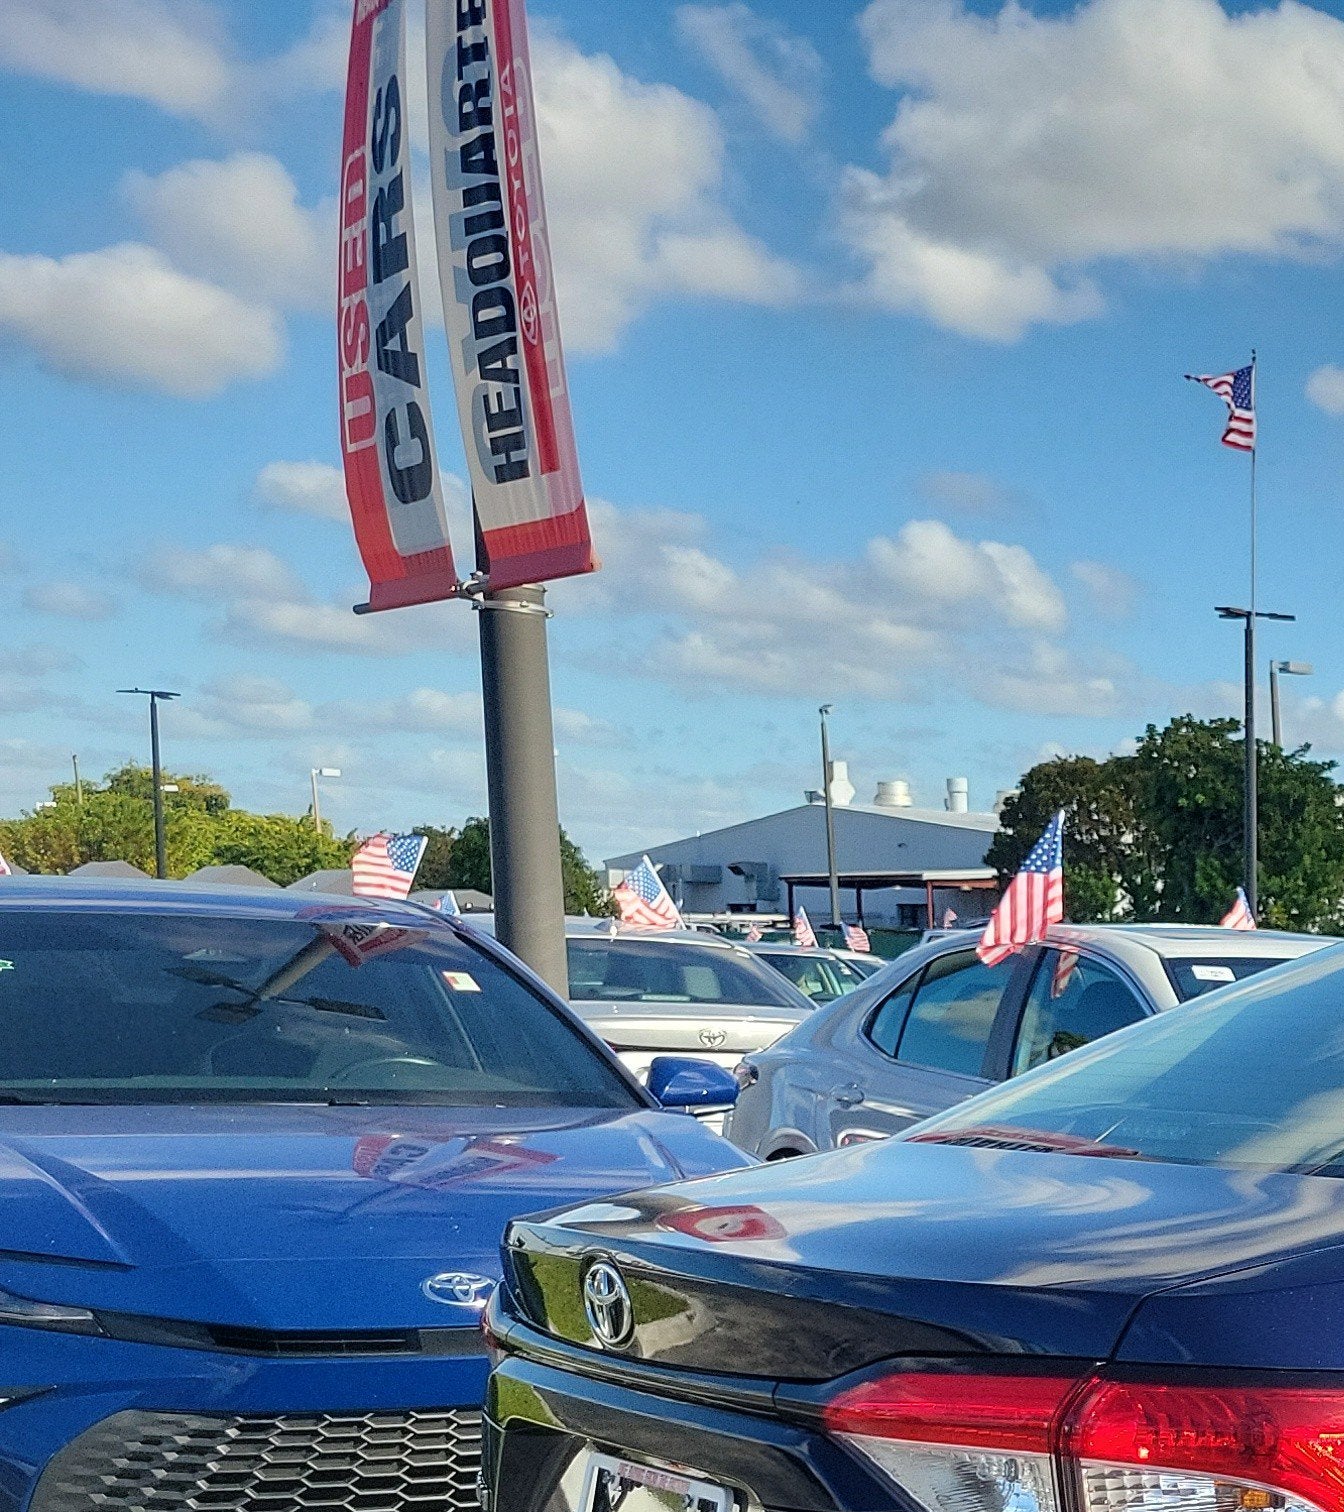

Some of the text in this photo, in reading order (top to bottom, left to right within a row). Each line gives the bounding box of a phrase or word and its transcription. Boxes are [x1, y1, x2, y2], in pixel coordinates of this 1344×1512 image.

[343, 145, 378, 453] USED
[370, 73, 433, 505] CARS
[499, 61, 529, 279] TOYOTA
